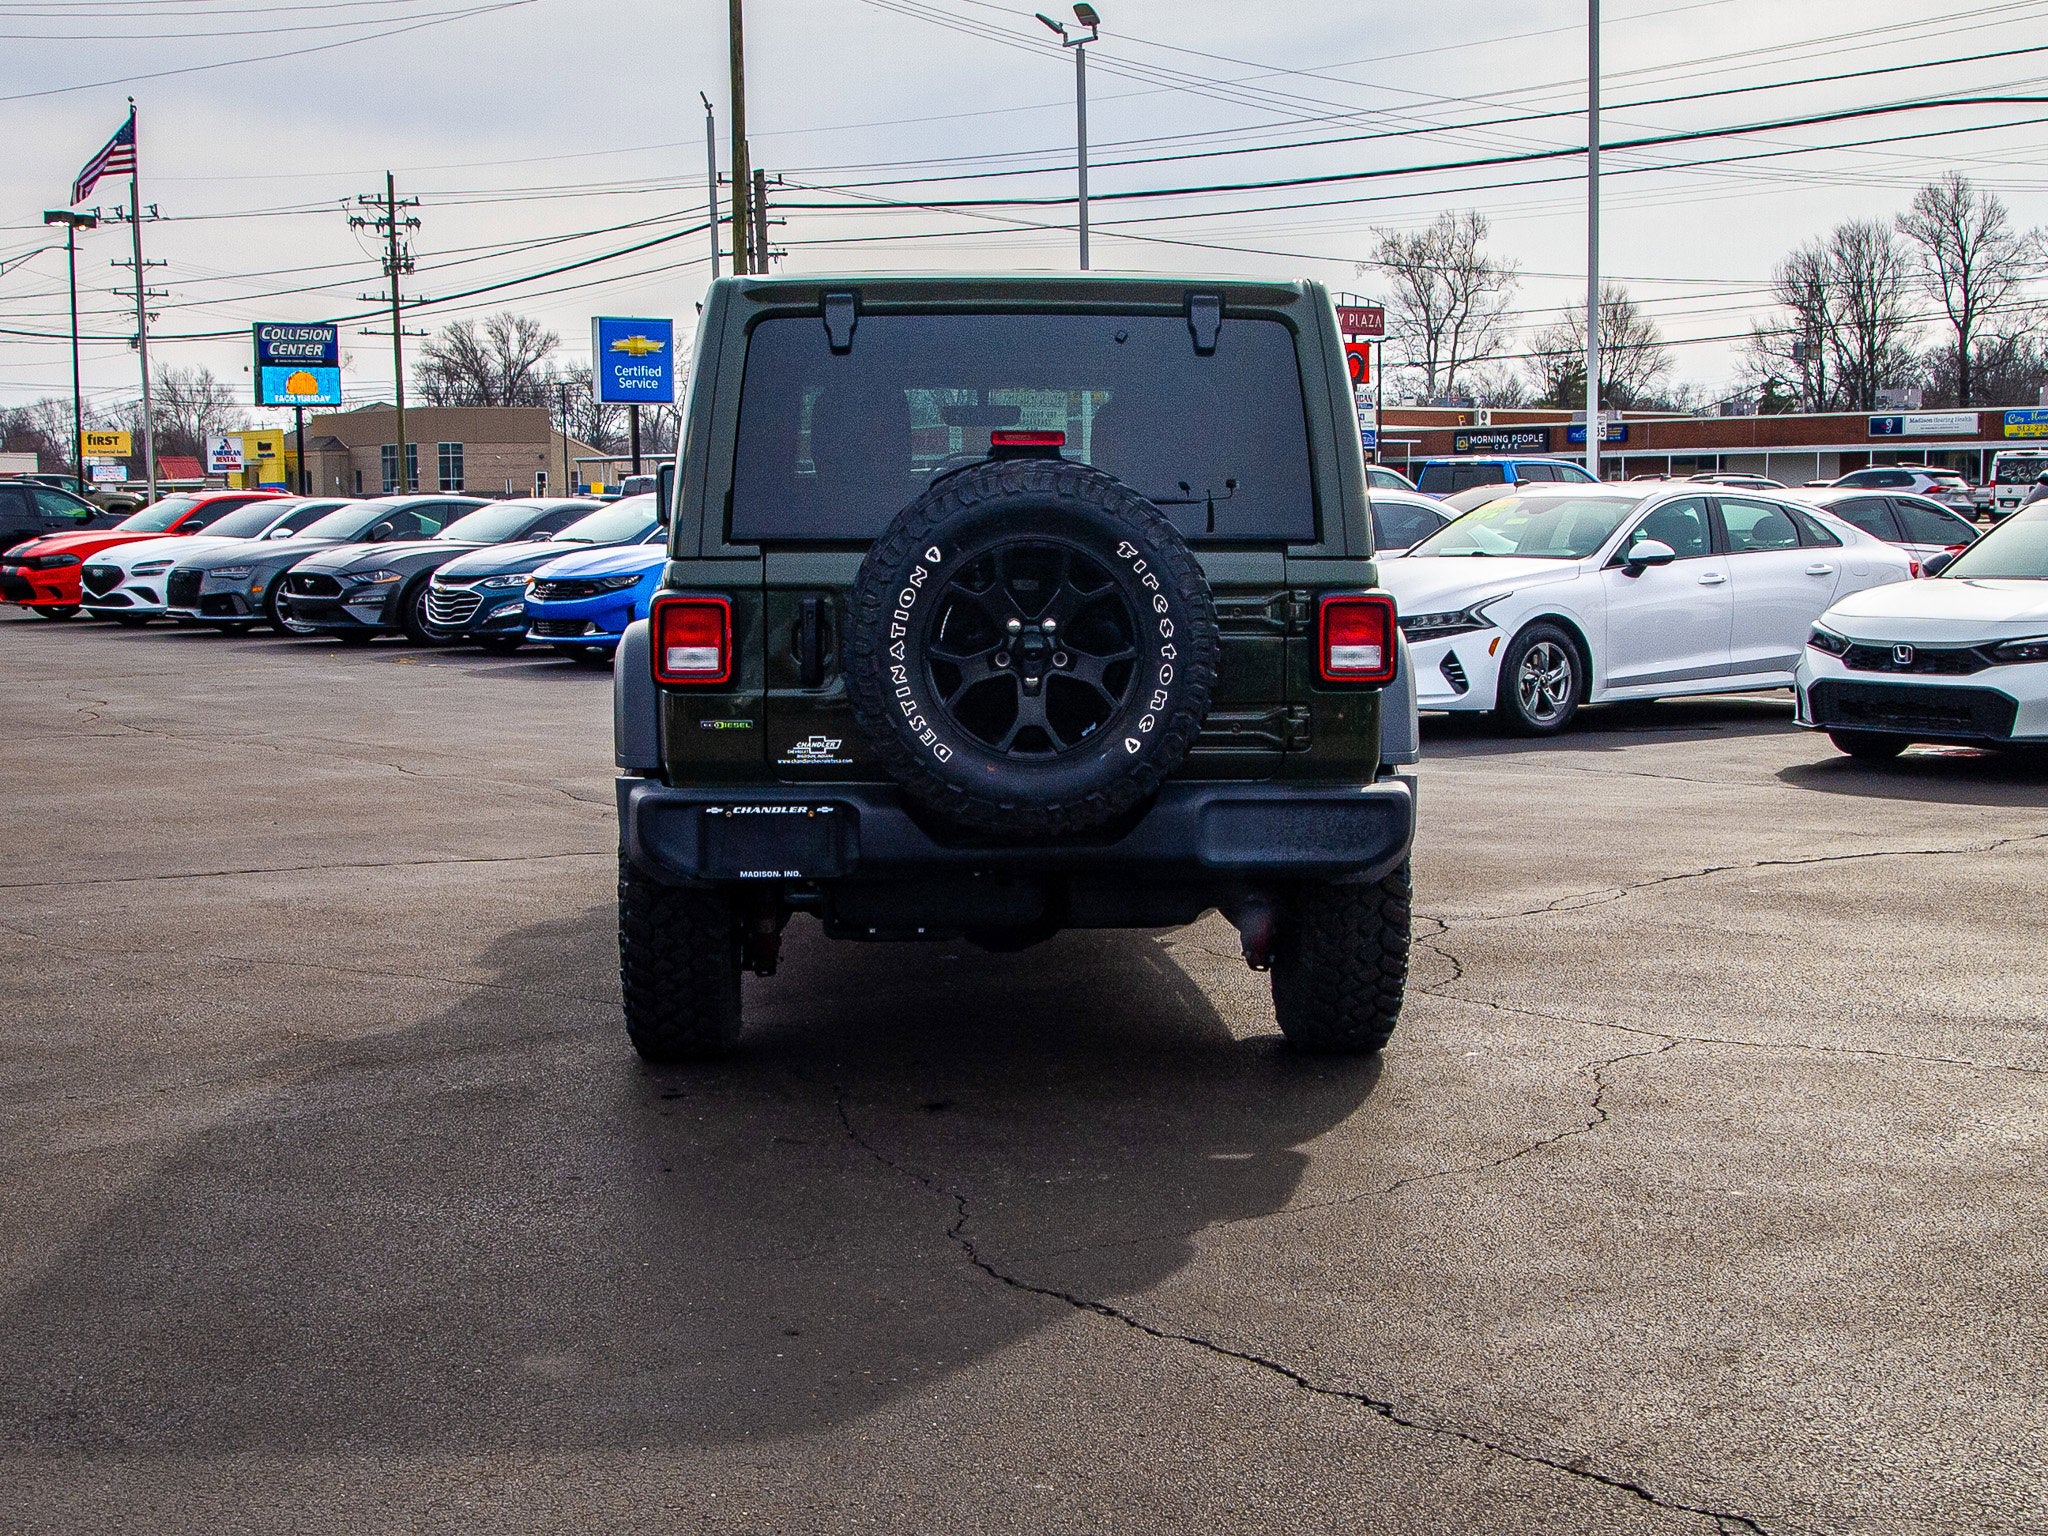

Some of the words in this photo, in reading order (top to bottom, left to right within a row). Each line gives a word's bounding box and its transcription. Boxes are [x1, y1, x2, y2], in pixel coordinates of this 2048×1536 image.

[1349, 313, 1382, 328] PLAZA
[261, 326, 332, 341] COLLISION
[269, 342, 323, 356] CENTER
[614, 365, 662, 377] Certified
[619, 377, 658, 389] Service
[1469, 434, 1509, 444] MORNING
[1511, 433, 1544, 443] PEOPLE
[889, 565, 953, 764] DESTINATION
[733, 806, 808, 814] CHANDLER
